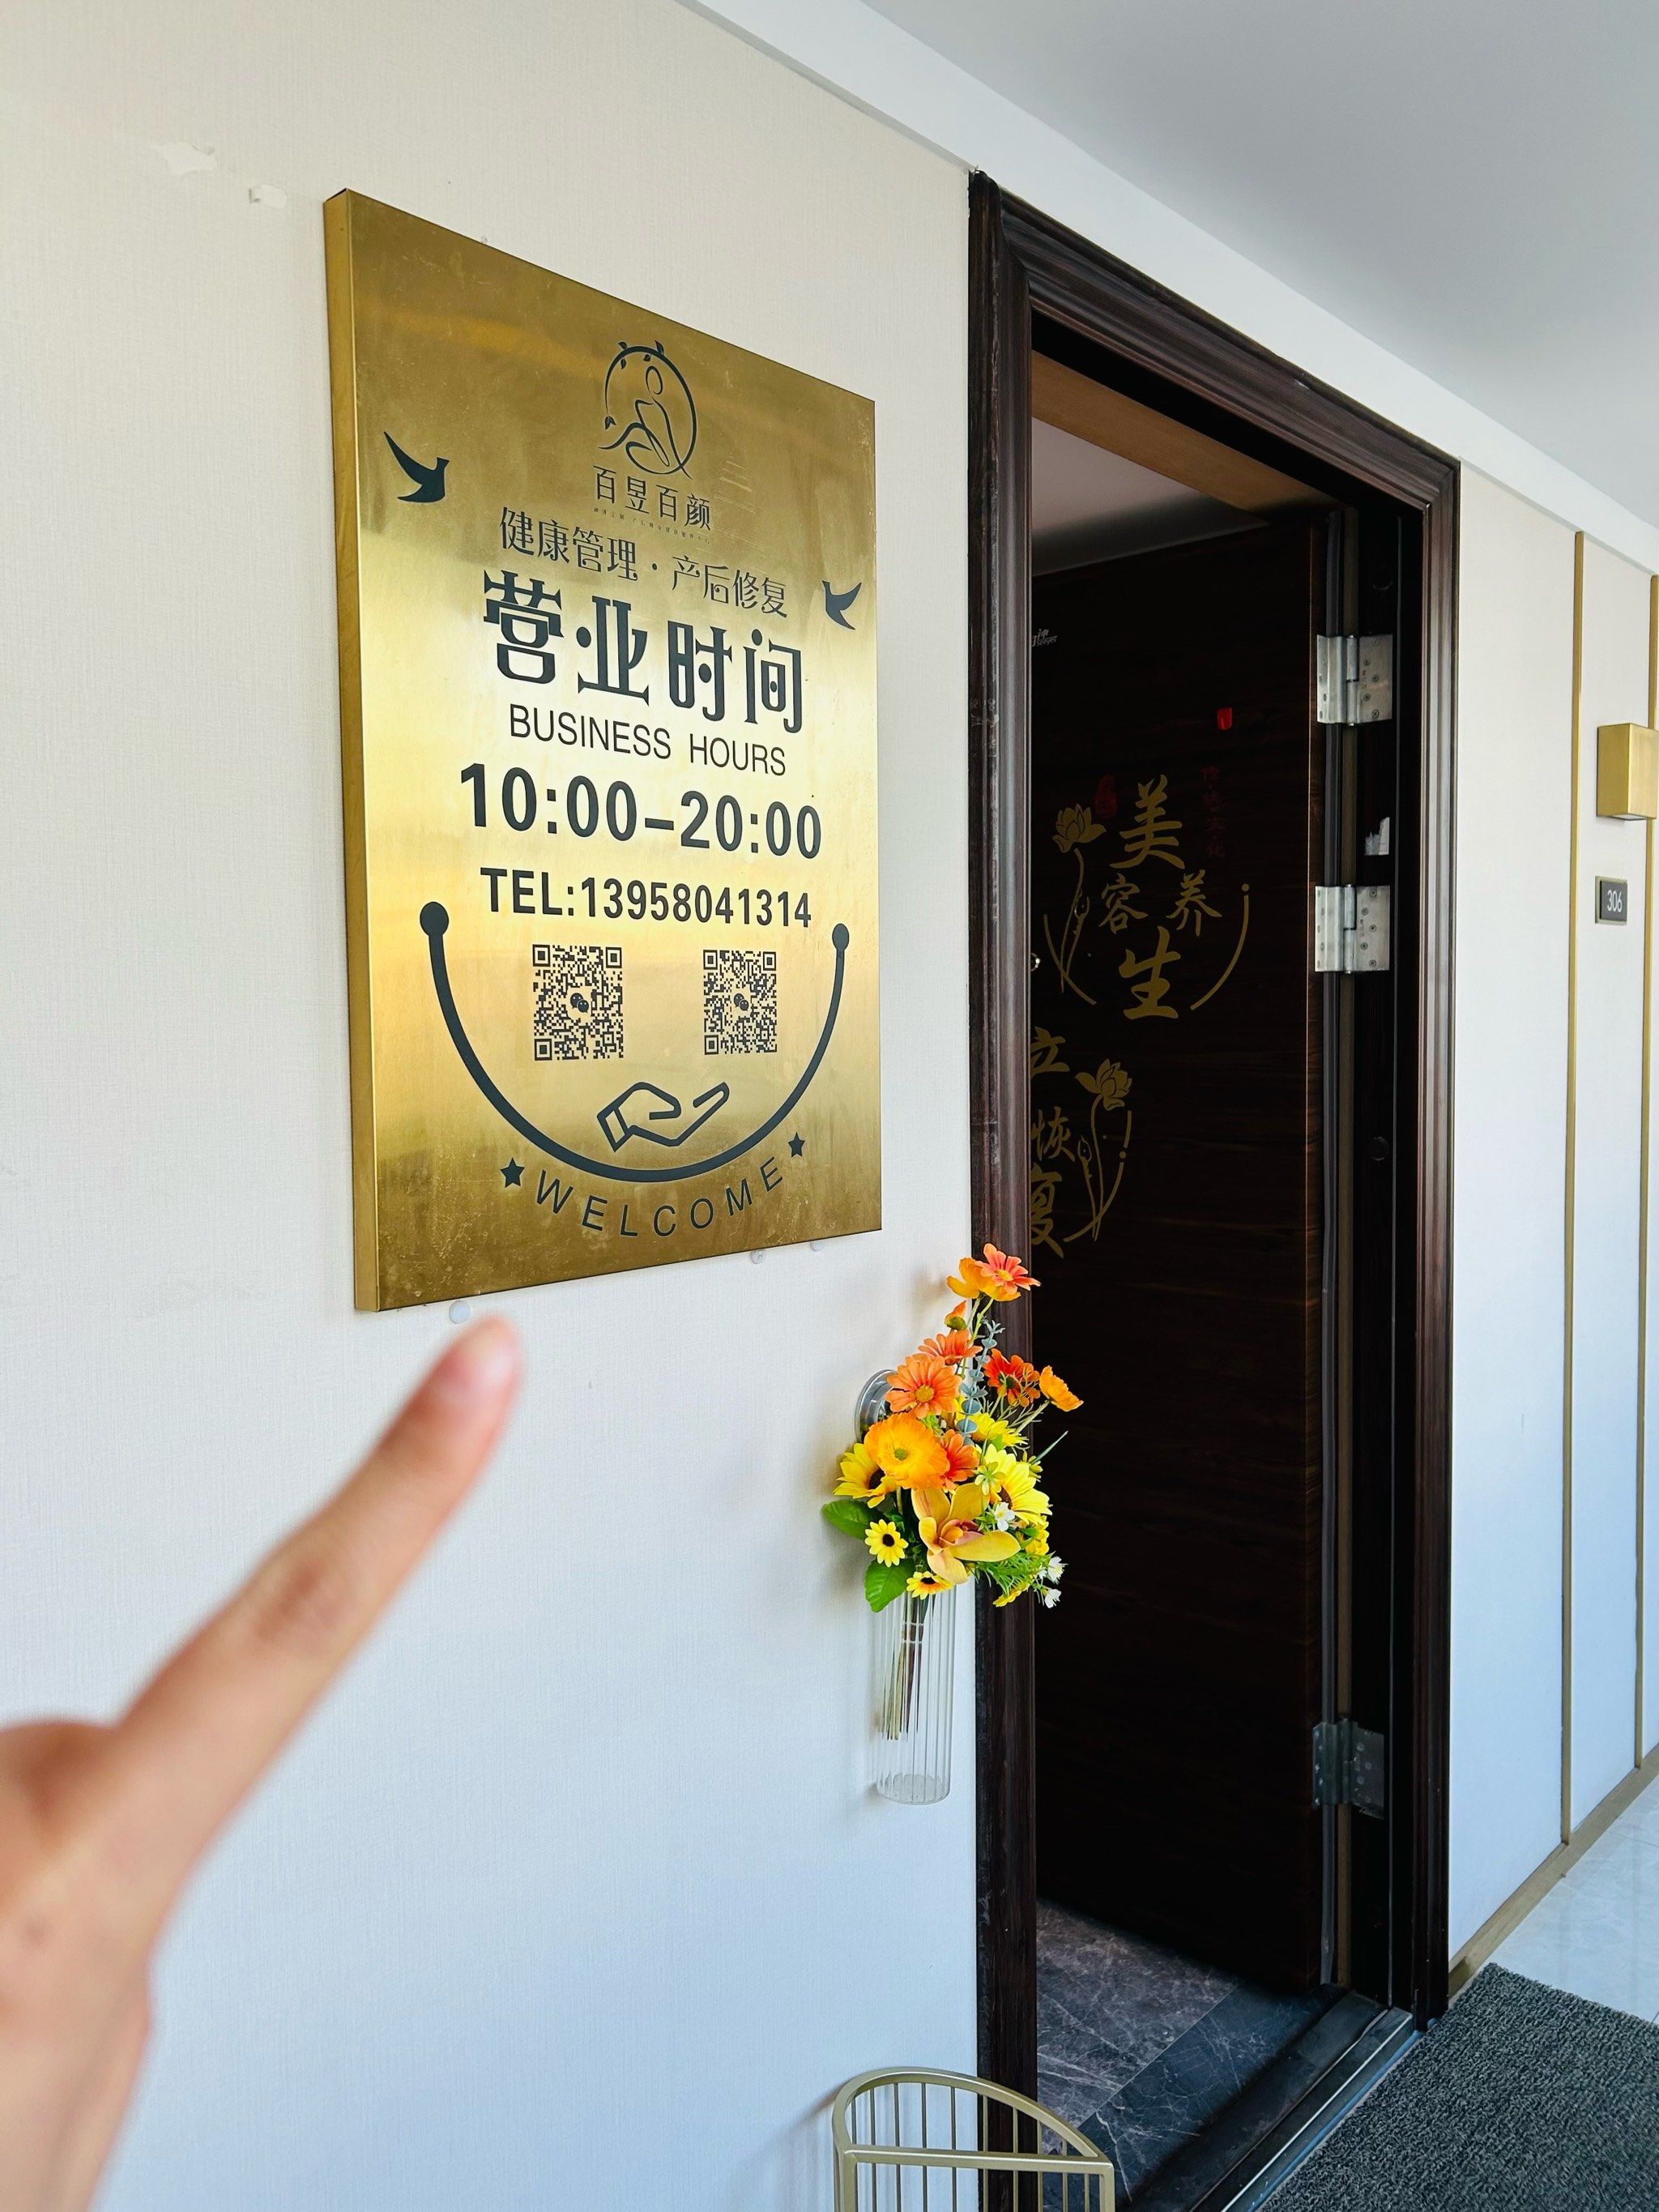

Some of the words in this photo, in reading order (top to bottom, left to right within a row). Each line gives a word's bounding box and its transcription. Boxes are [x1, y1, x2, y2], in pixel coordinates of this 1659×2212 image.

[592, 464, 711, 532] 百昱百颜
[483, 569, 804, 733] 营业时间
[510, 703, 672, 760] BUSINESS
[689, 733, 787, 776] HOURS
[480, 867, 812, 928] TEL:13958041314
[1606, 889, 1623, 912] 306
[535, 1155, 783, 1237] WELCOME
